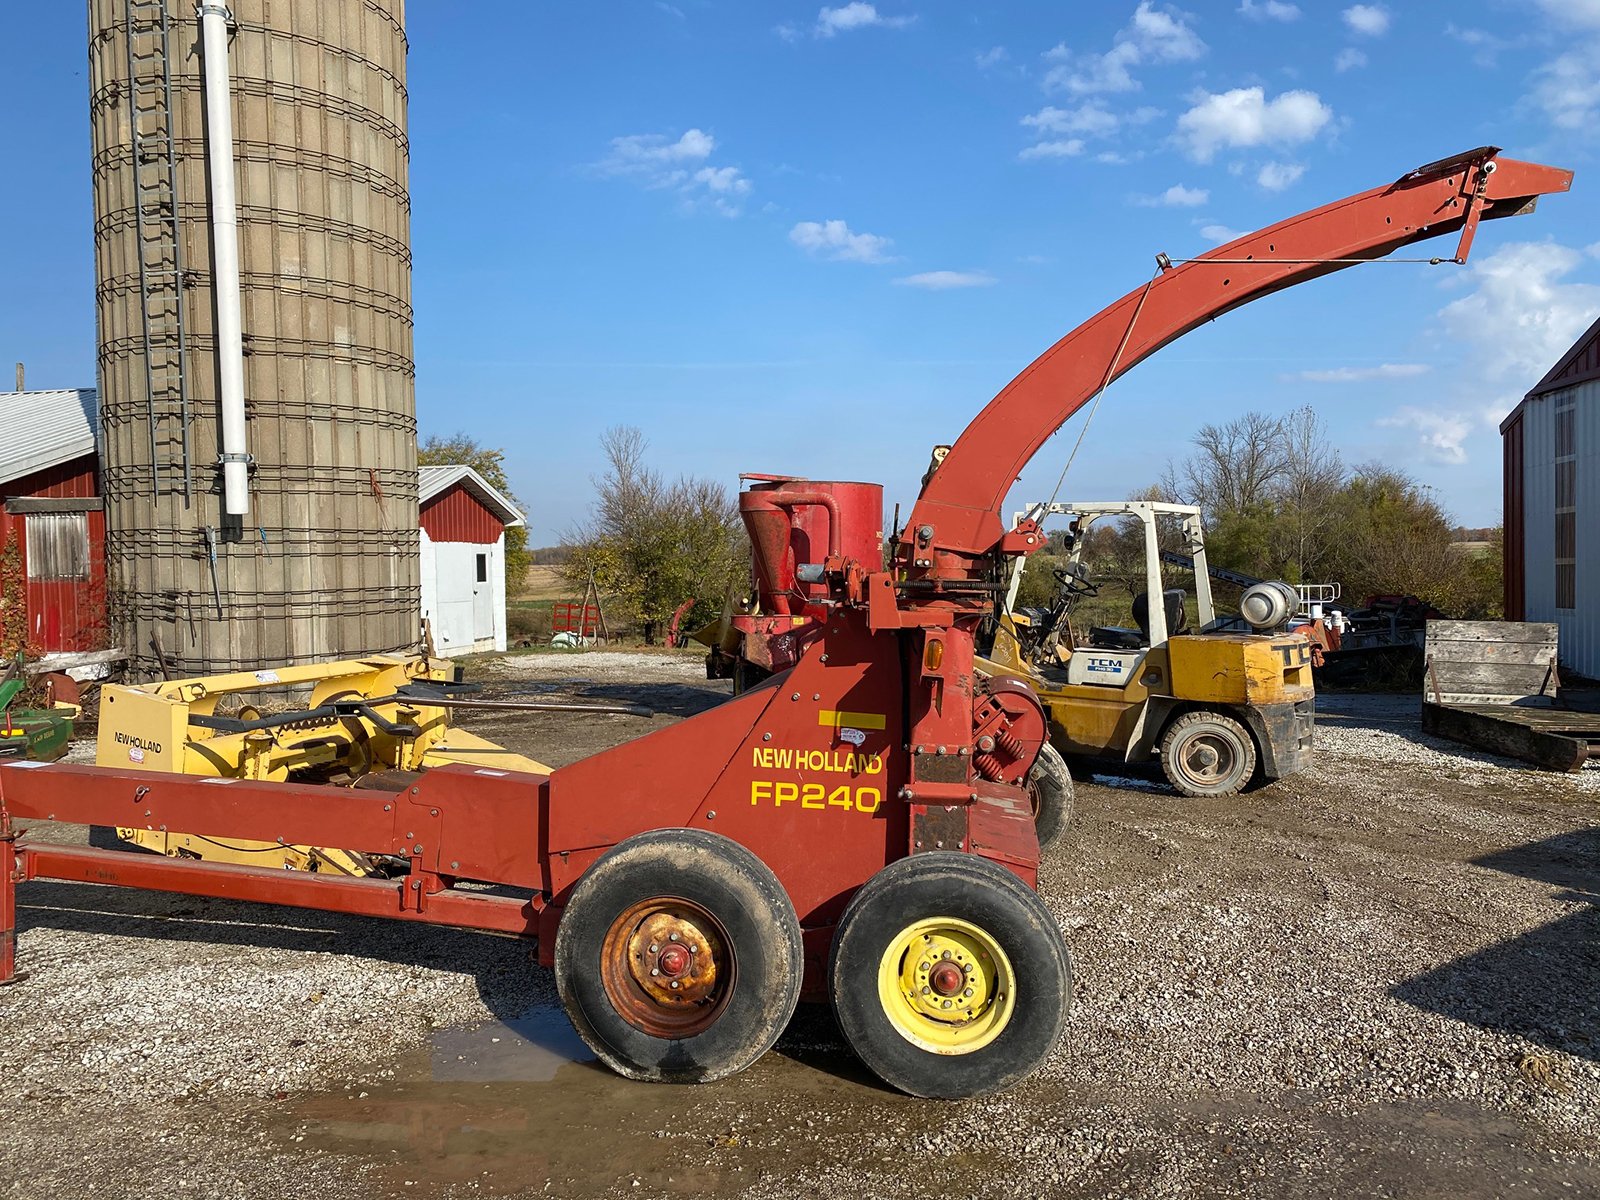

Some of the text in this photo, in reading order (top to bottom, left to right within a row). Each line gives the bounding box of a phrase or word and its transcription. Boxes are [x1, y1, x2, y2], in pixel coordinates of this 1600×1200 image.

[1088, 658, 1122, 667] TCM
[115, 732, 162, 754] NEW HOLLAND
[753, 747, 882, 774] NEW HOLLAND
[751, 781, 881, 813] FP240
